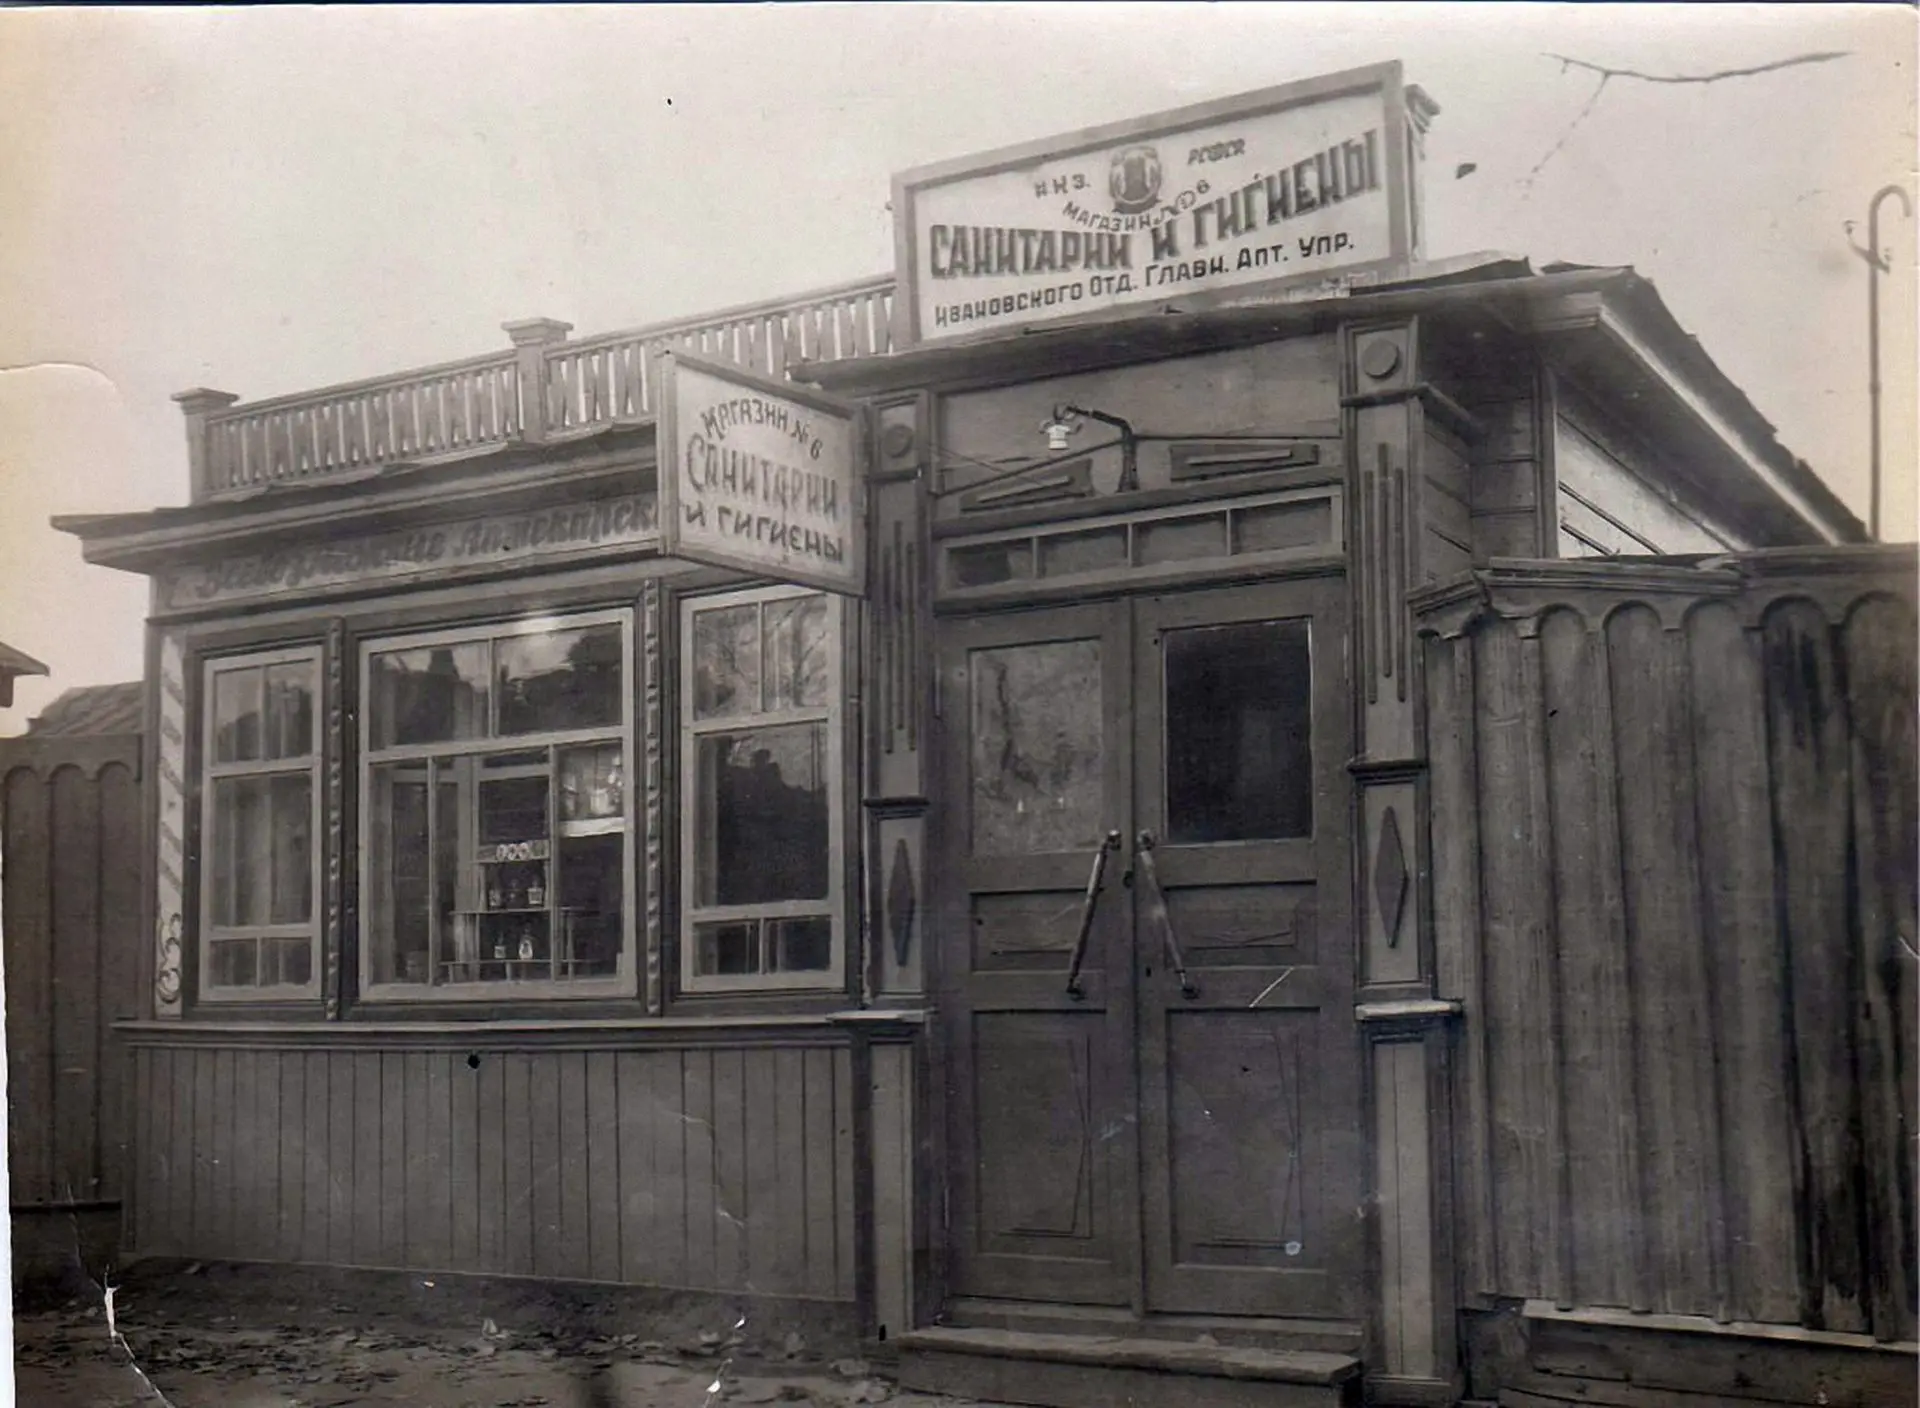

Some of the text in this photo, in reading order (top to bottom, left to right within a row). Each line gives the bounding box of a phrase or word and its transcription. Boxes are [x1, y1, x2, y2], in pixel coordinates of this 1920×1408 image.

[930, 128, 1382, 279] САНИТАРИИ И ГИГИЕНЫ
[701, 399, 788, 440] МАГАЗИН
